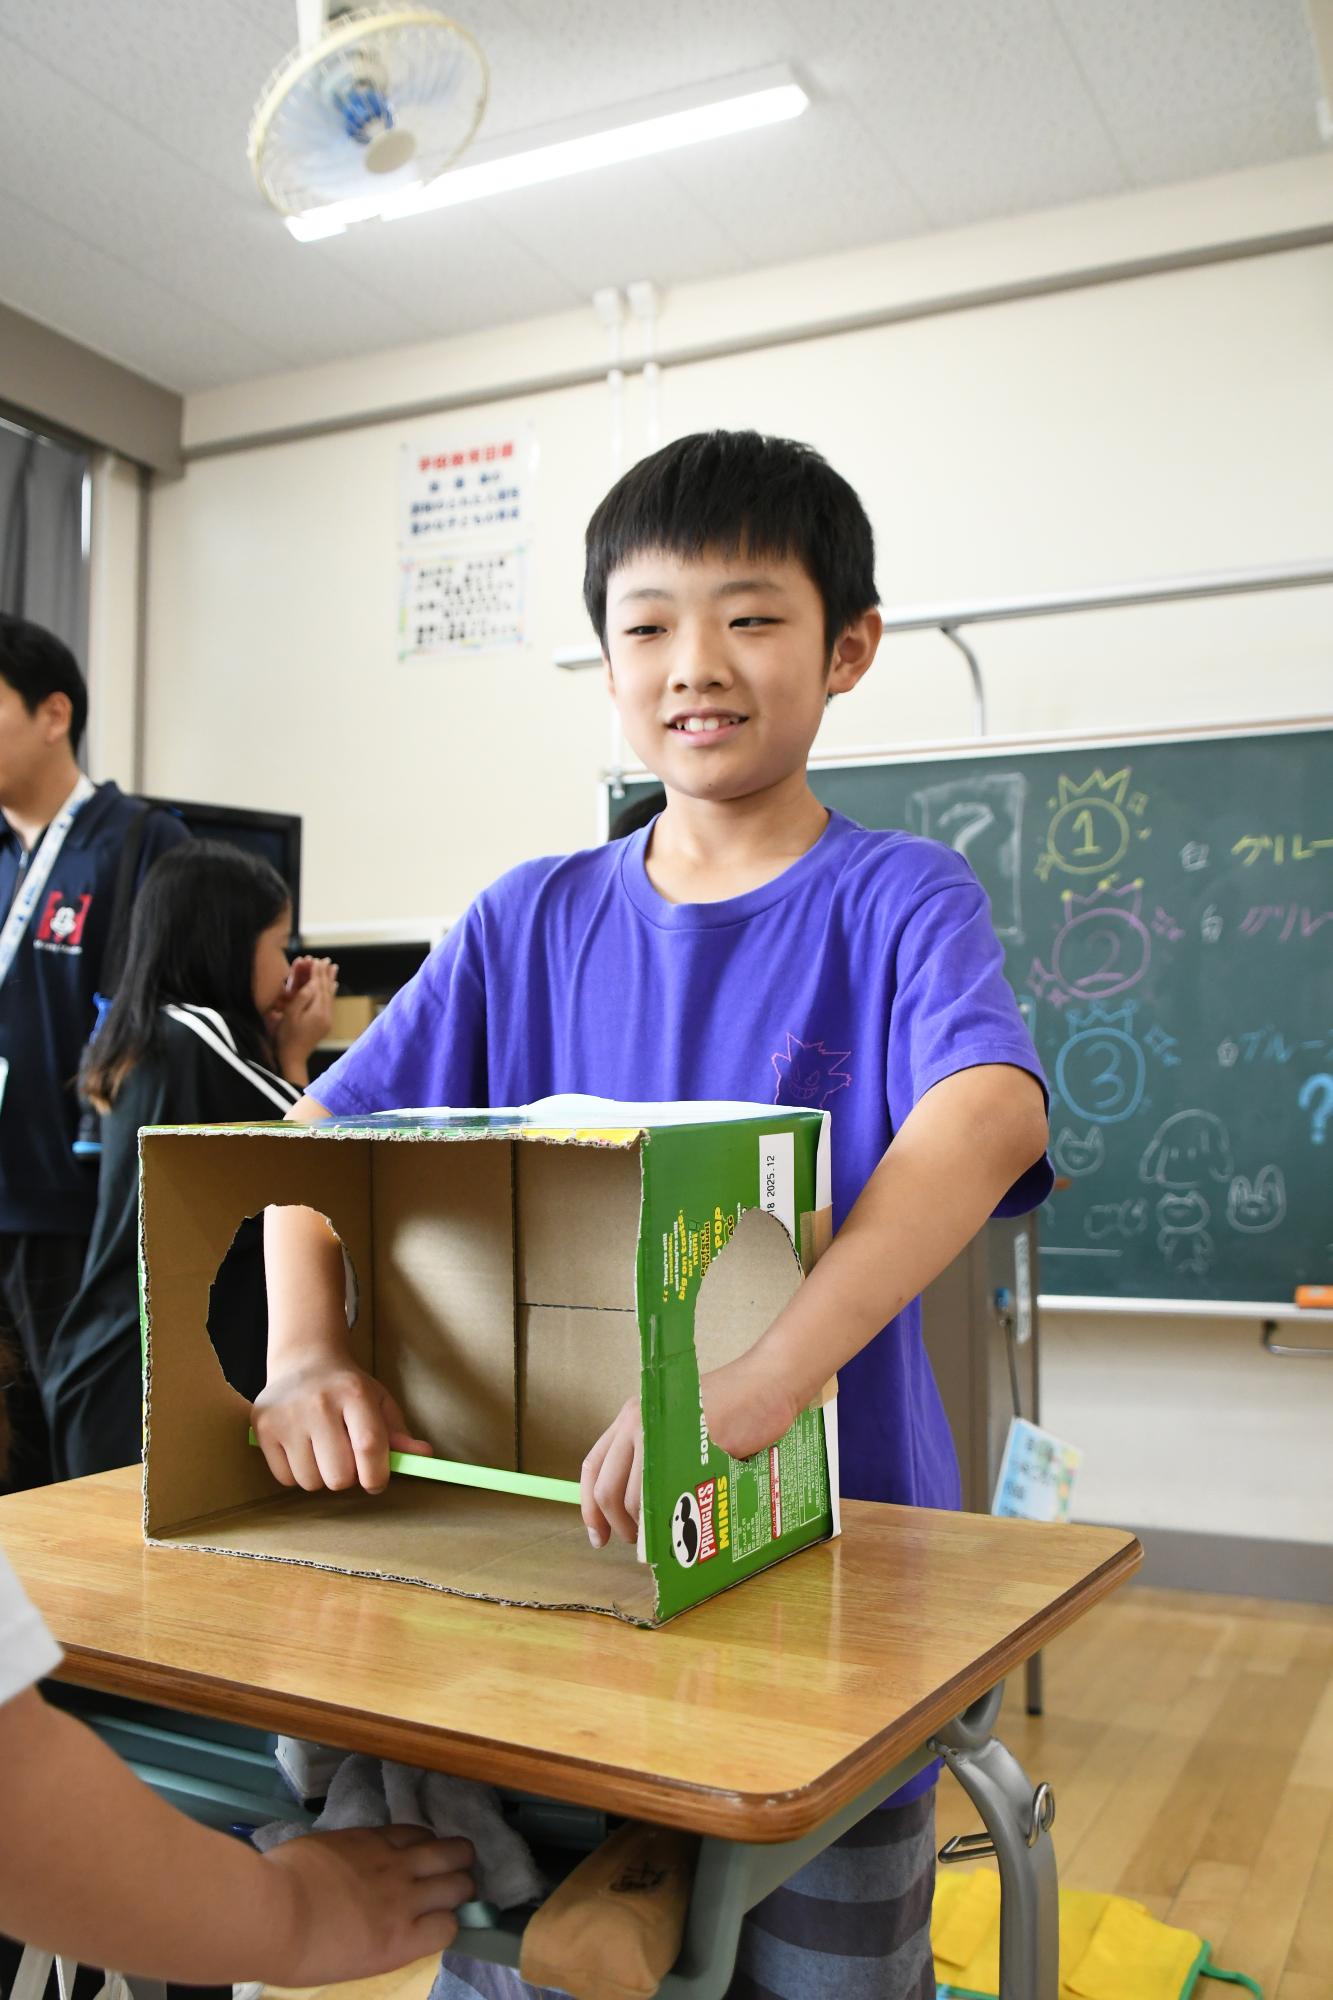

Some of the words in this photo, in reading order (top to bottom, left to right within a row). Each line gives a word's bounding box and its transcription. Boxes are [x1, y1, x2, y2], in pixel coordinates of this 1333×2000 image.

[766, 1154, 775, 1198] 2025.12
[714, 1206, 723, 1249] POP
[681, 1255, 688, 1274] on
[679, 1277, 688, 1301] big
[697, 1482, 717, 1561] PRINGLES
[717, 1475, 730, 1550] MINIS
